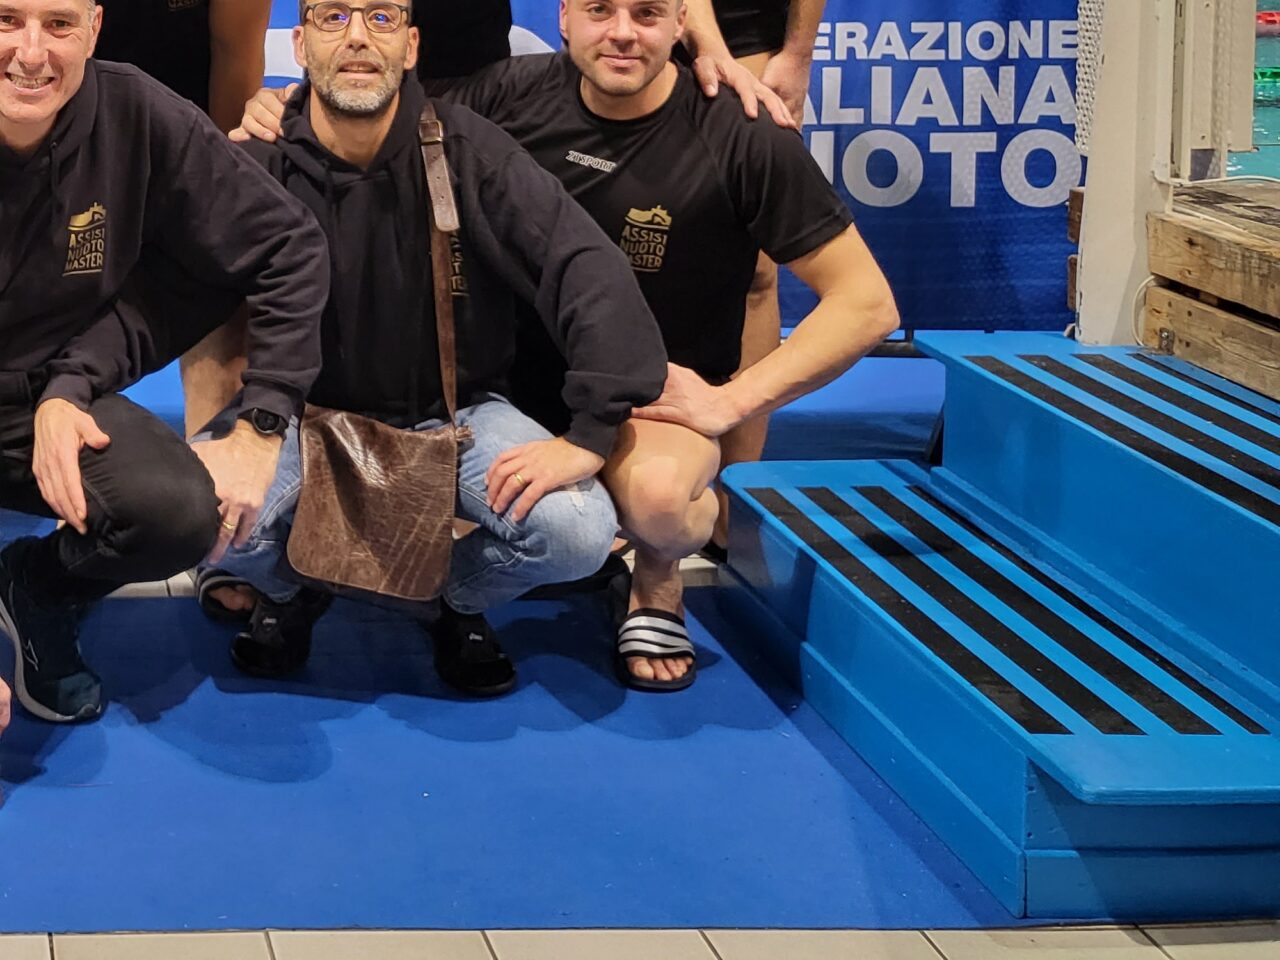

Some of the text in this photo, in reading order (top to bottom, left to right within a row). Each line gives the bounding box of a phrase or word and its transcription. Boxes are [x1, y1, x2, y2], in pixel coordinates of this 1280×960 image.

[811, 19, 1079, 61] ERAZIONE
[802, 65, 1077, 126] LIANA
[810, 128, 1082, 208] OTO
[622, 225, 668, 245] ASSISI
[67, 239, 105, 261] NUOTO
[621, 239, 665, 256] NUOTO
[64, 252, 104, 271] MASTER
[629, 254, 662, 268] ASTER
